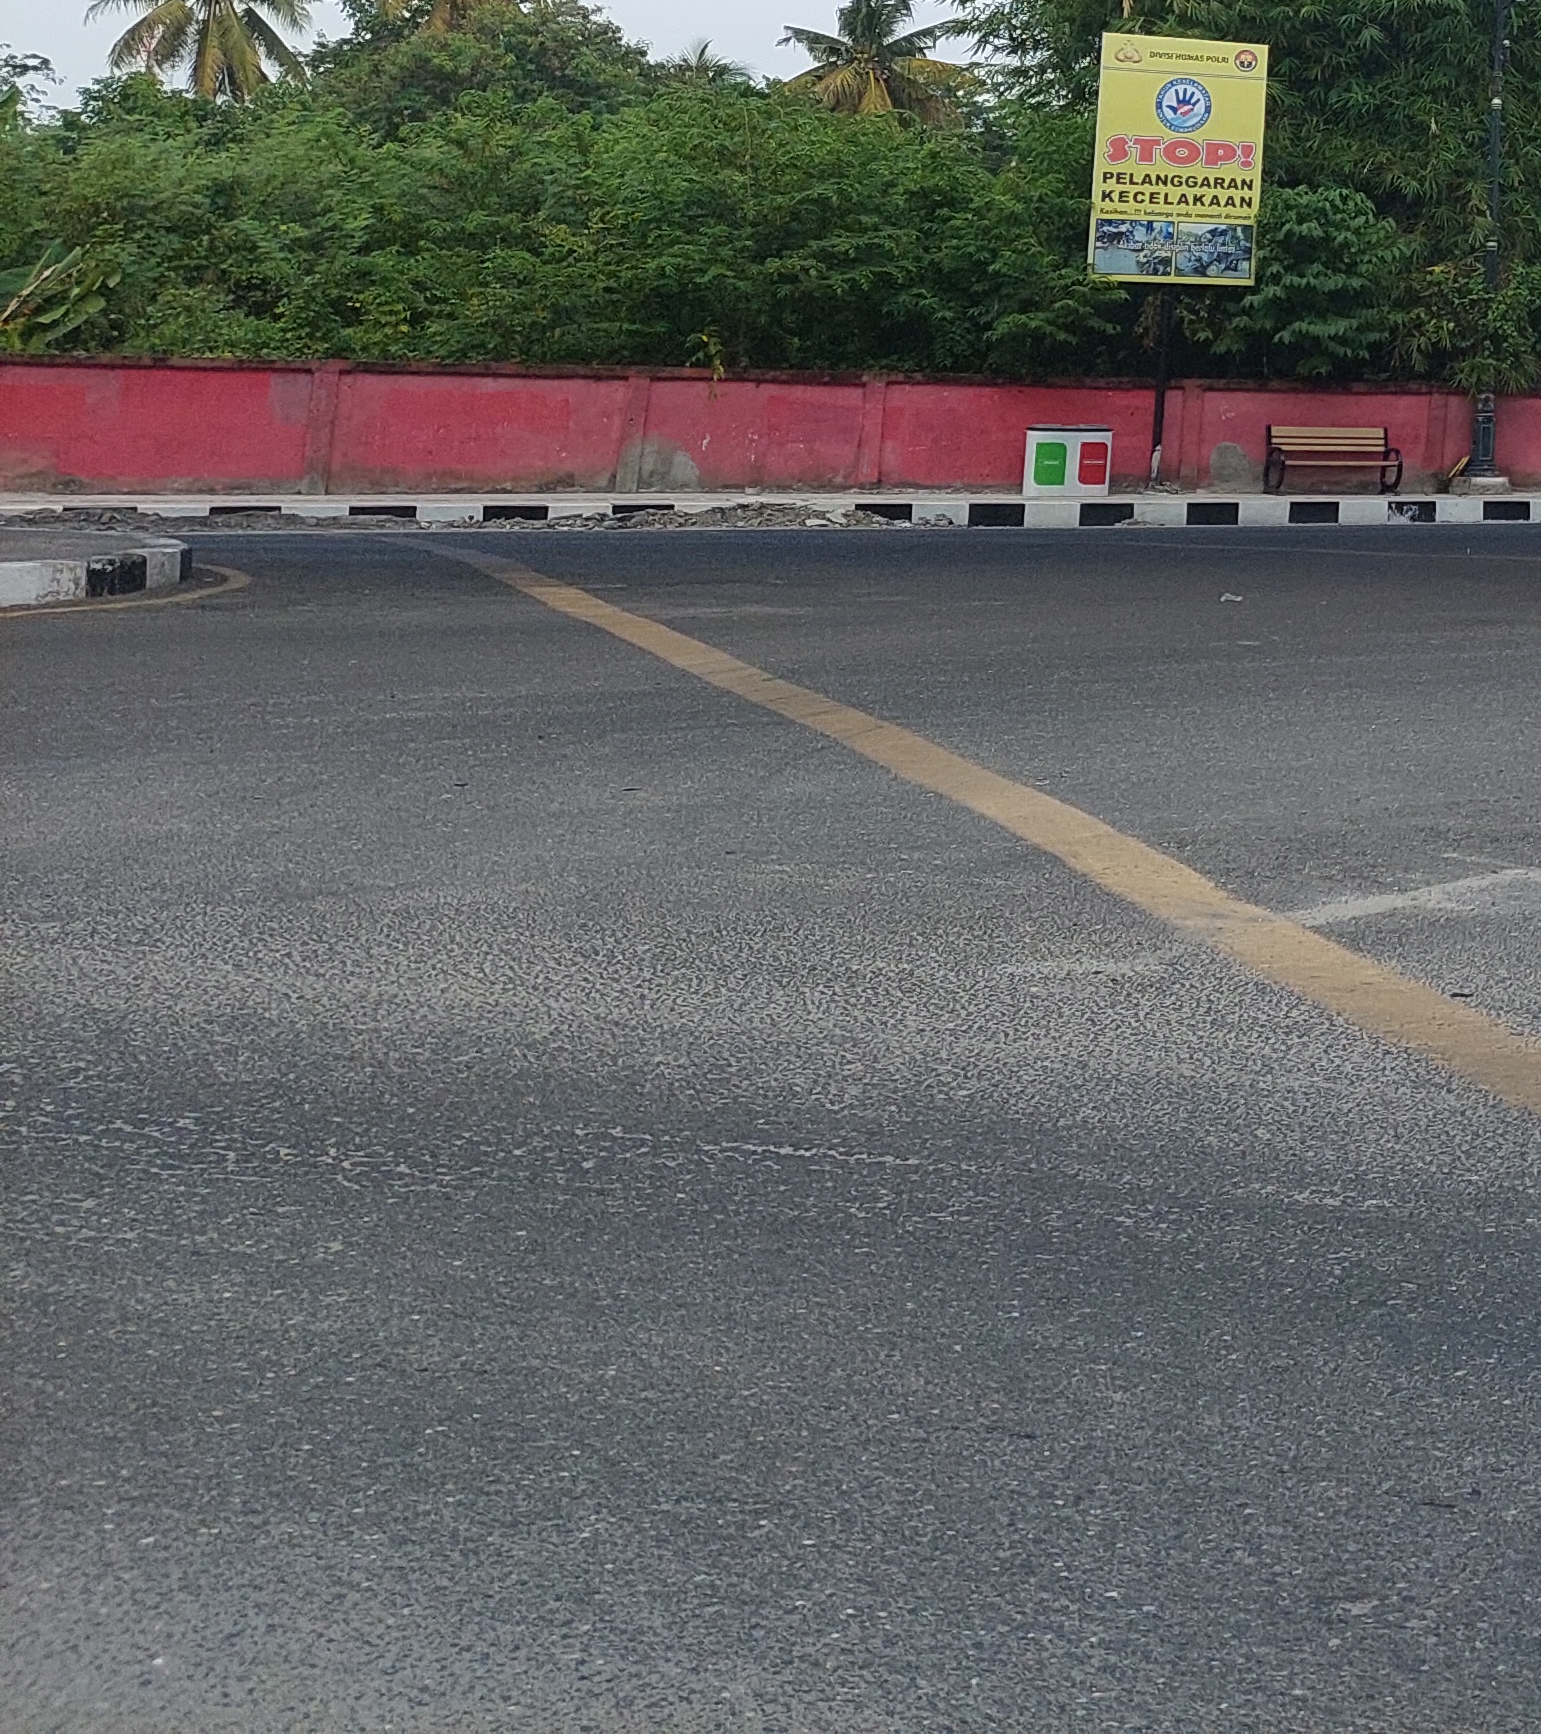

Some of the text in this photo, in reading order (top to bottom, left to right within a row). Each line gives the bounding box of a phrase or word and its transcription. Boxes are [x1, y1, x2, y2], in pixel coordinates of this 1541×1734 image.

[1175, 53, 1204, 62] HUMAS
[1206, 55, 1229, 64] POLRI
[1103, 134, 1256, 170] STOP!
[1101, 171, 1254, 192] PELANGGARAN
[1100, 189, 1253, 209] KECELAKAAN
